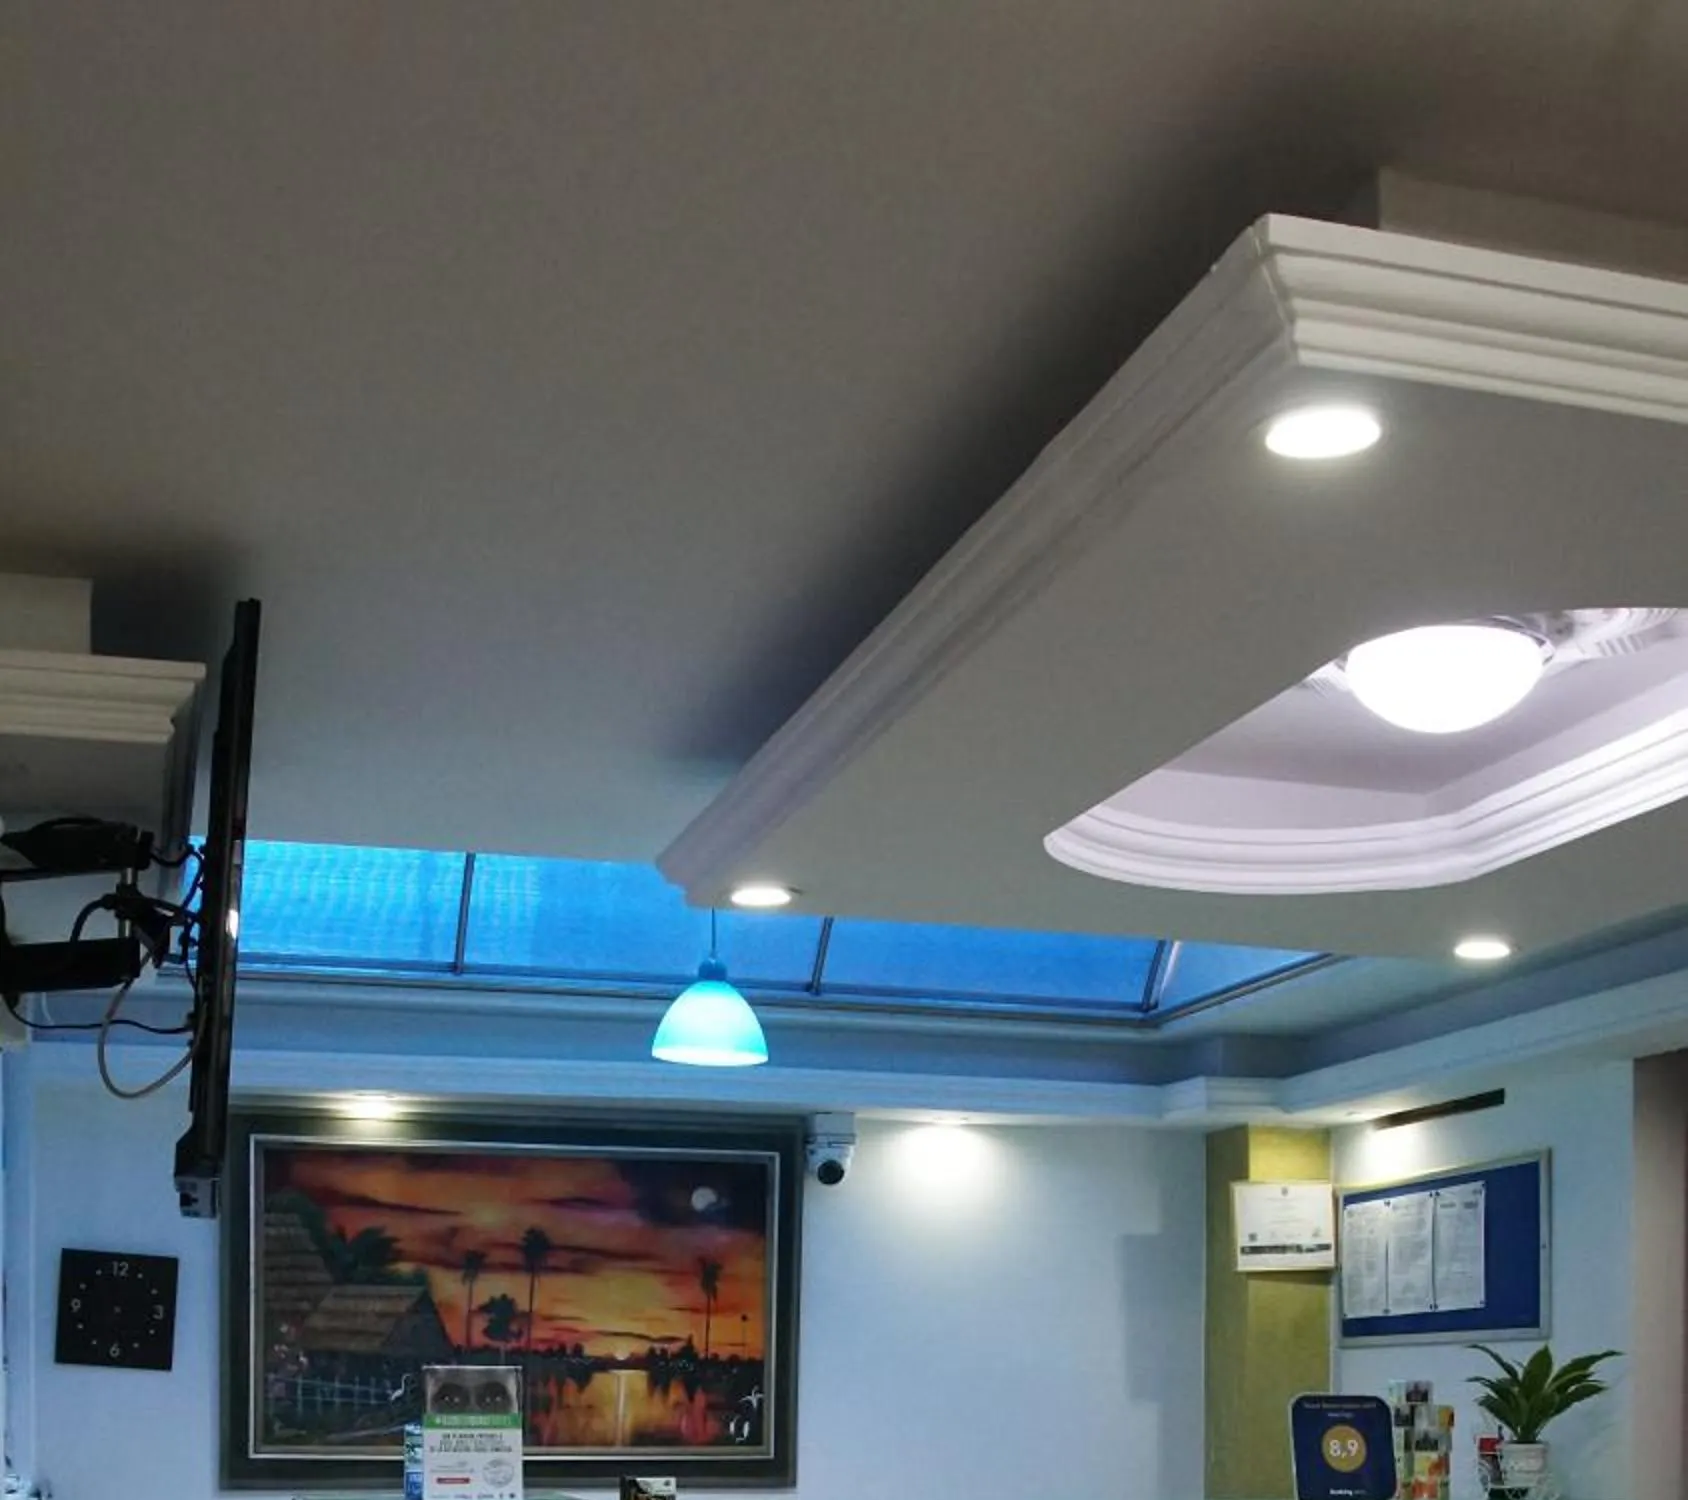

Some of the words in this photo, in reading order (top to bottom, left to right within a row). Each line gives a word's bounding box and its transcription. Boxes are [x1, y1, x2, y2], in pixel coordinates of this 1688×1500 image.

[112, 1261, 129, 1277] 12
[70, 1298, 81, 1312] 9
[152, 1304, 164, 1320] 3
[109, 1343, 120, 1358] 6
